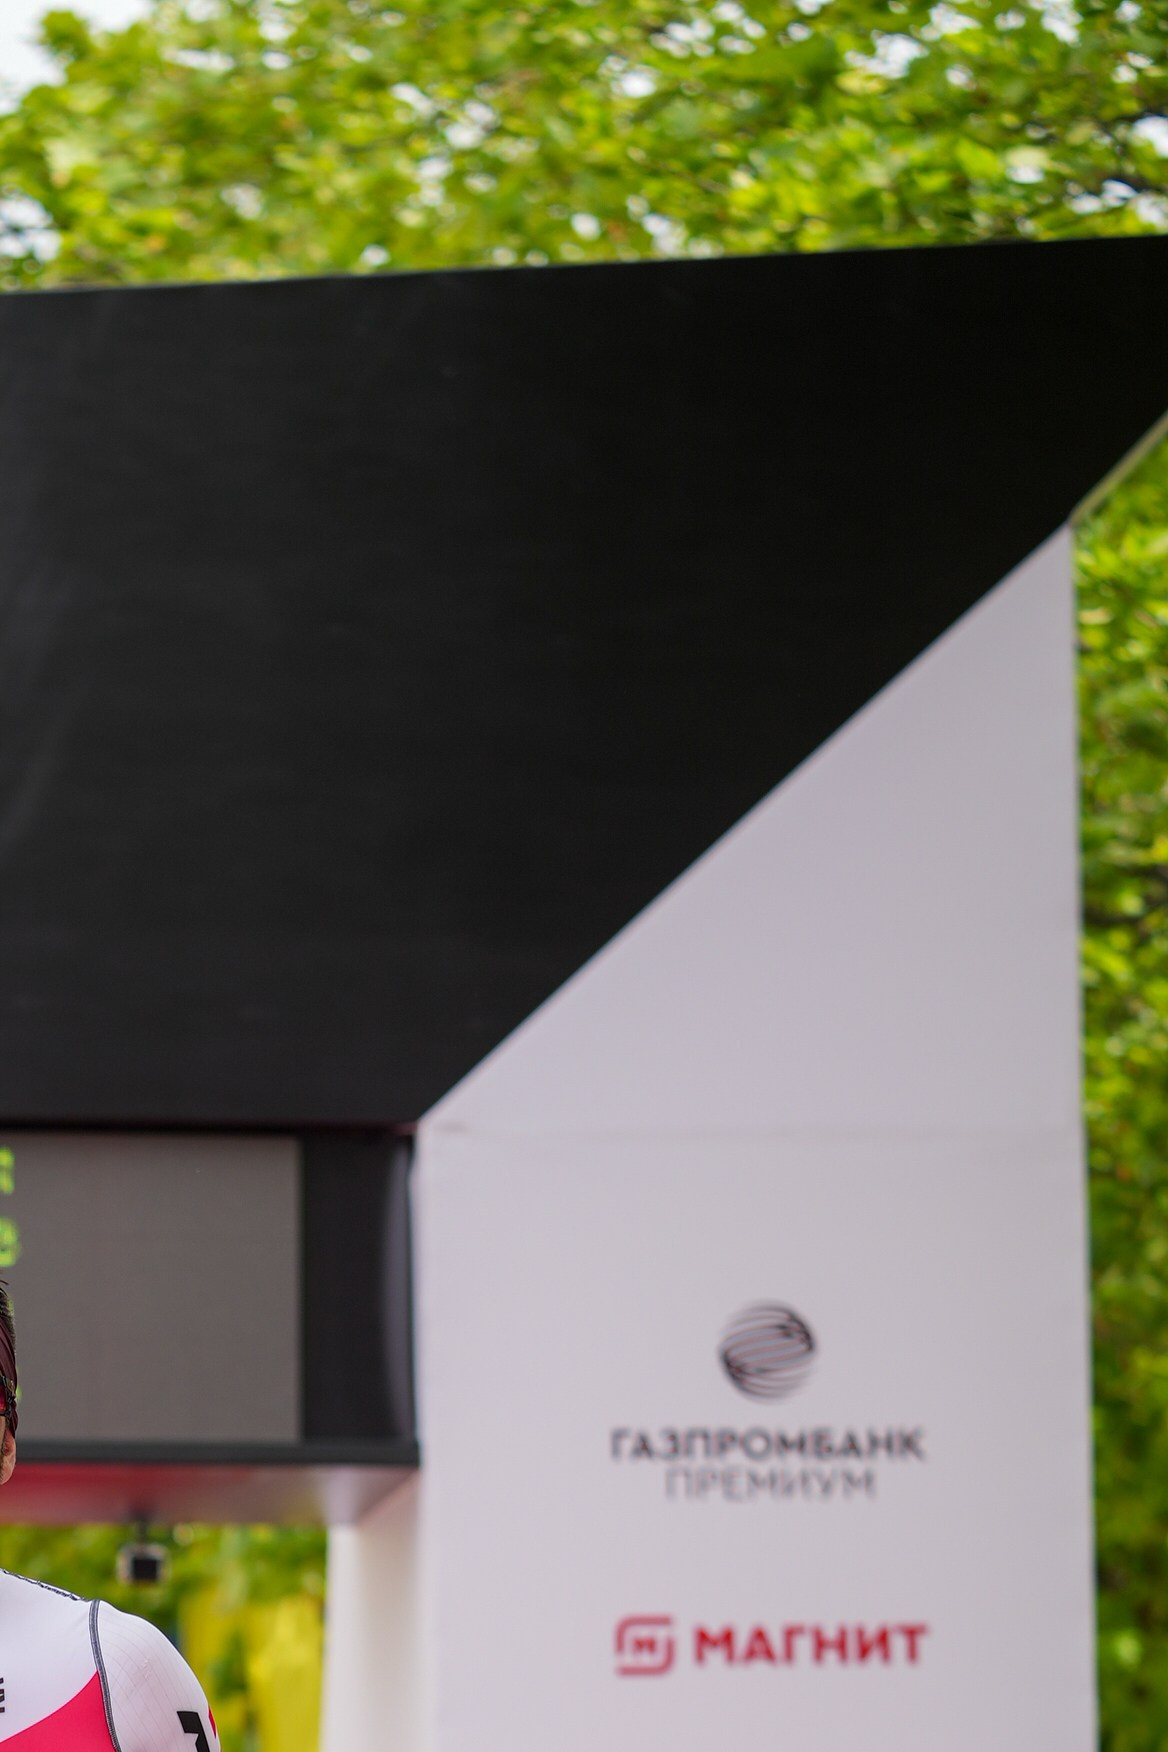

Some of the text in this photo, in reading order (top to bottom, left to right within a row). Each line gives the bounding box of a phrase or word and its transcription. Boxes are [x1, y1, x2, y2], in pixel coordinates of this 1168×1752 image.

[610, 1427, 924, 1462] ГАЗПРОМБАНК
[665, 1468, 876, 1500] ПРЕМИУМ
[694, 1625, 928, 1666] МАГНИТ
